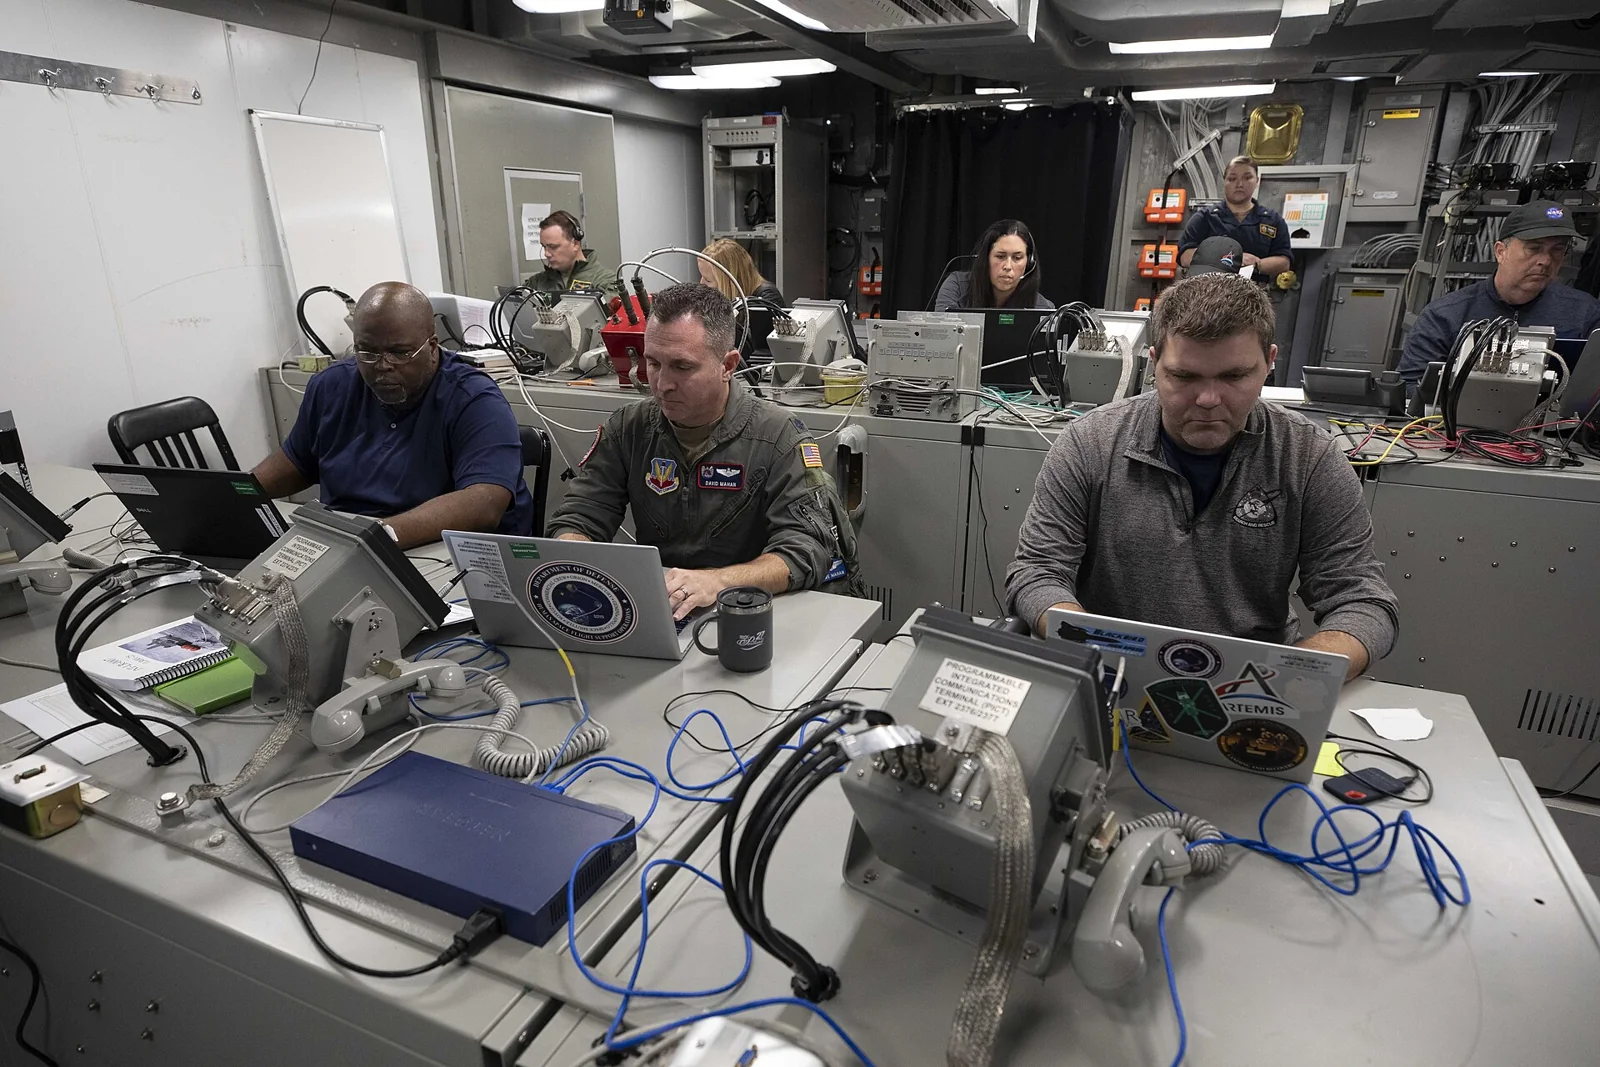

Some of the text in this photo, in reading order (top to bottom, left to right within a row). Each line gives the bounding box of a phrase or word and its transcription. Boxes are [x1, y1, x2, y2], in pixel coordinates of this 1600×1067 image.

[291, 543, 317, 556] INTEGRATED
[294, 536, 327, 552] PROGRAMMABLE
[533, 565, 572, 588] DEPARTMENT
[586, 569, 619, 593] DEFENSE
[1093, 629, 1145, 643] BLACKBIRD
[946, 661, 1025, 689] PROGRAMMABLE
[951, 672, 1010, 695] INTEGRATED
[935, 677, 1019, 708] COMMUNICATIONS
[935, 686, 978, 705] TERMINAL
[935, 697, 953, 707] EXT
